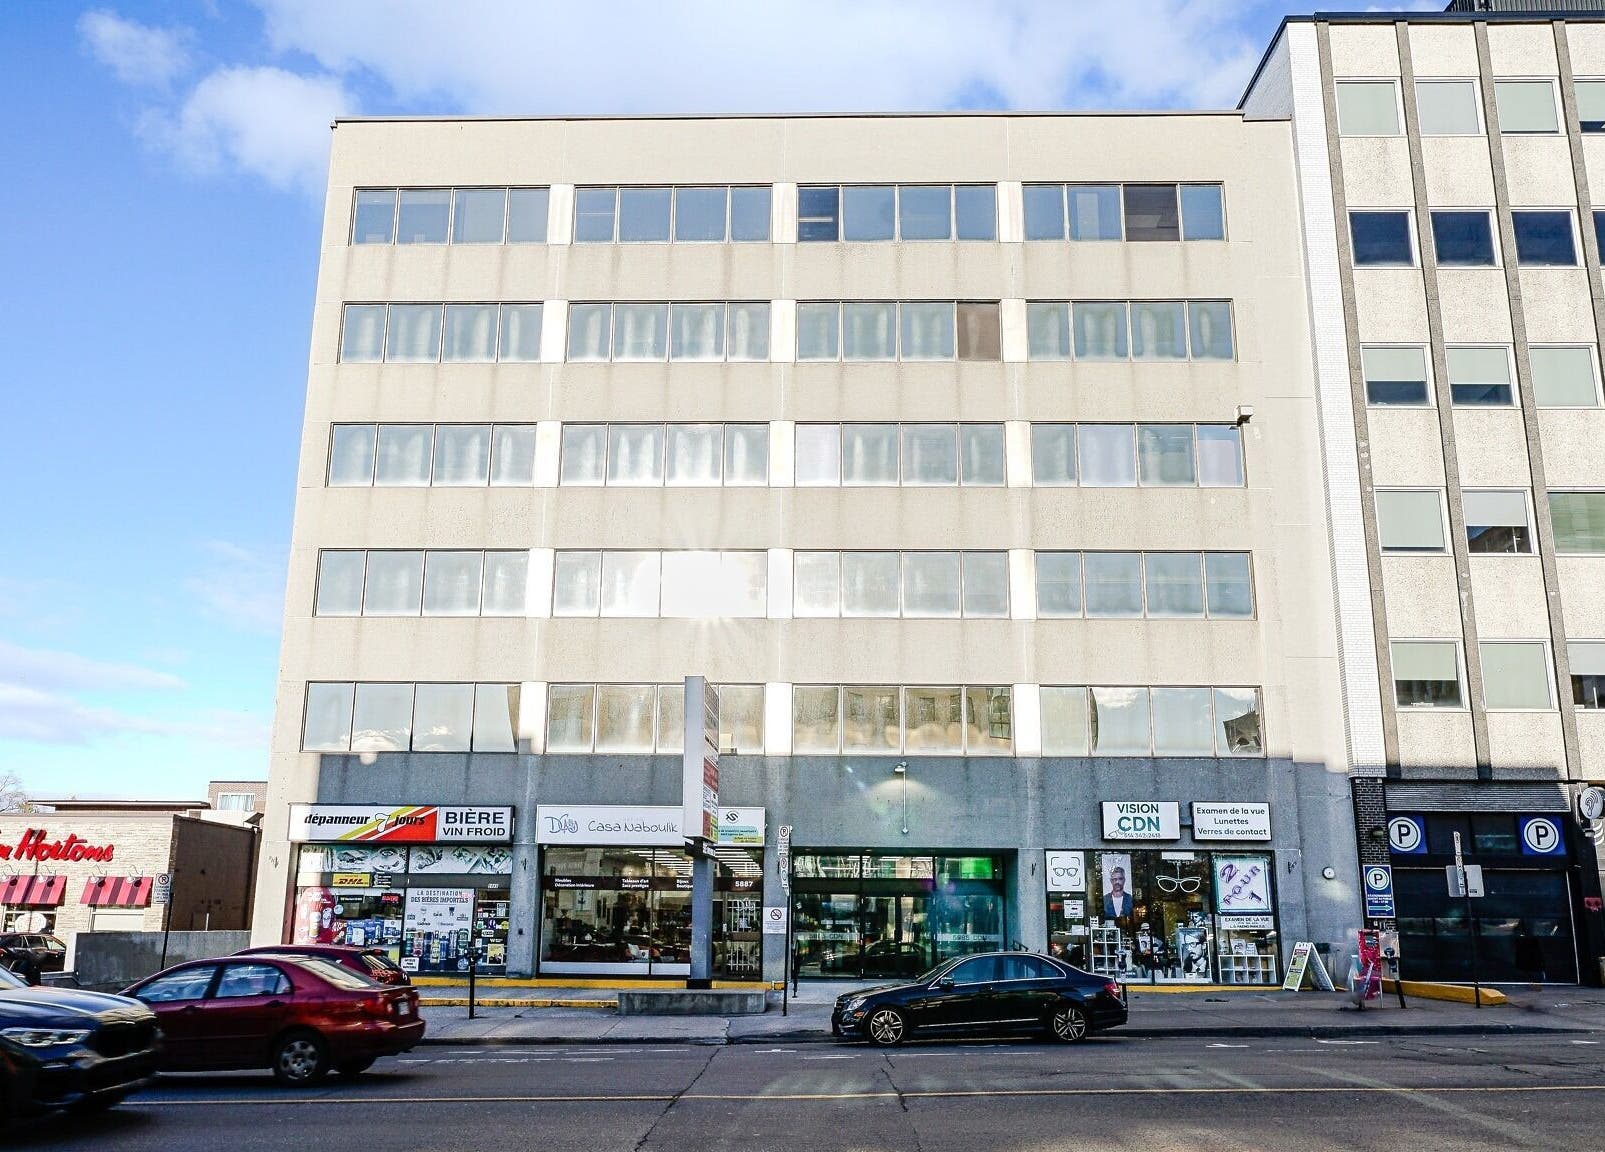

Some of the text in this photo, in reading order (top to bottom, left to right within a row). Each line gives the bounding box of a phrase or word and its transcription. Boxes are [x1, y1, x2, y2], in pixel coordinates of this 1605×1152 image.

[446, 808, 504, 824] BIÈRE
[1117, 803, 1159, 814] VISION
[304, 812, 425, 833] dépanneur 7 jours
[588, 820, 621, 832] Casa
[624, 821, 678, 833] Naboulik
[1118, 816, 1160, 832] CDN
[443, 827, 506, 836] VIN FROID
[14, 828, 114, 862] Hortons
[1220, 864, 1239, 884] 2
[1223, 866, 1261, 905] POUR
[1249, 891, 1262, 902] 1
